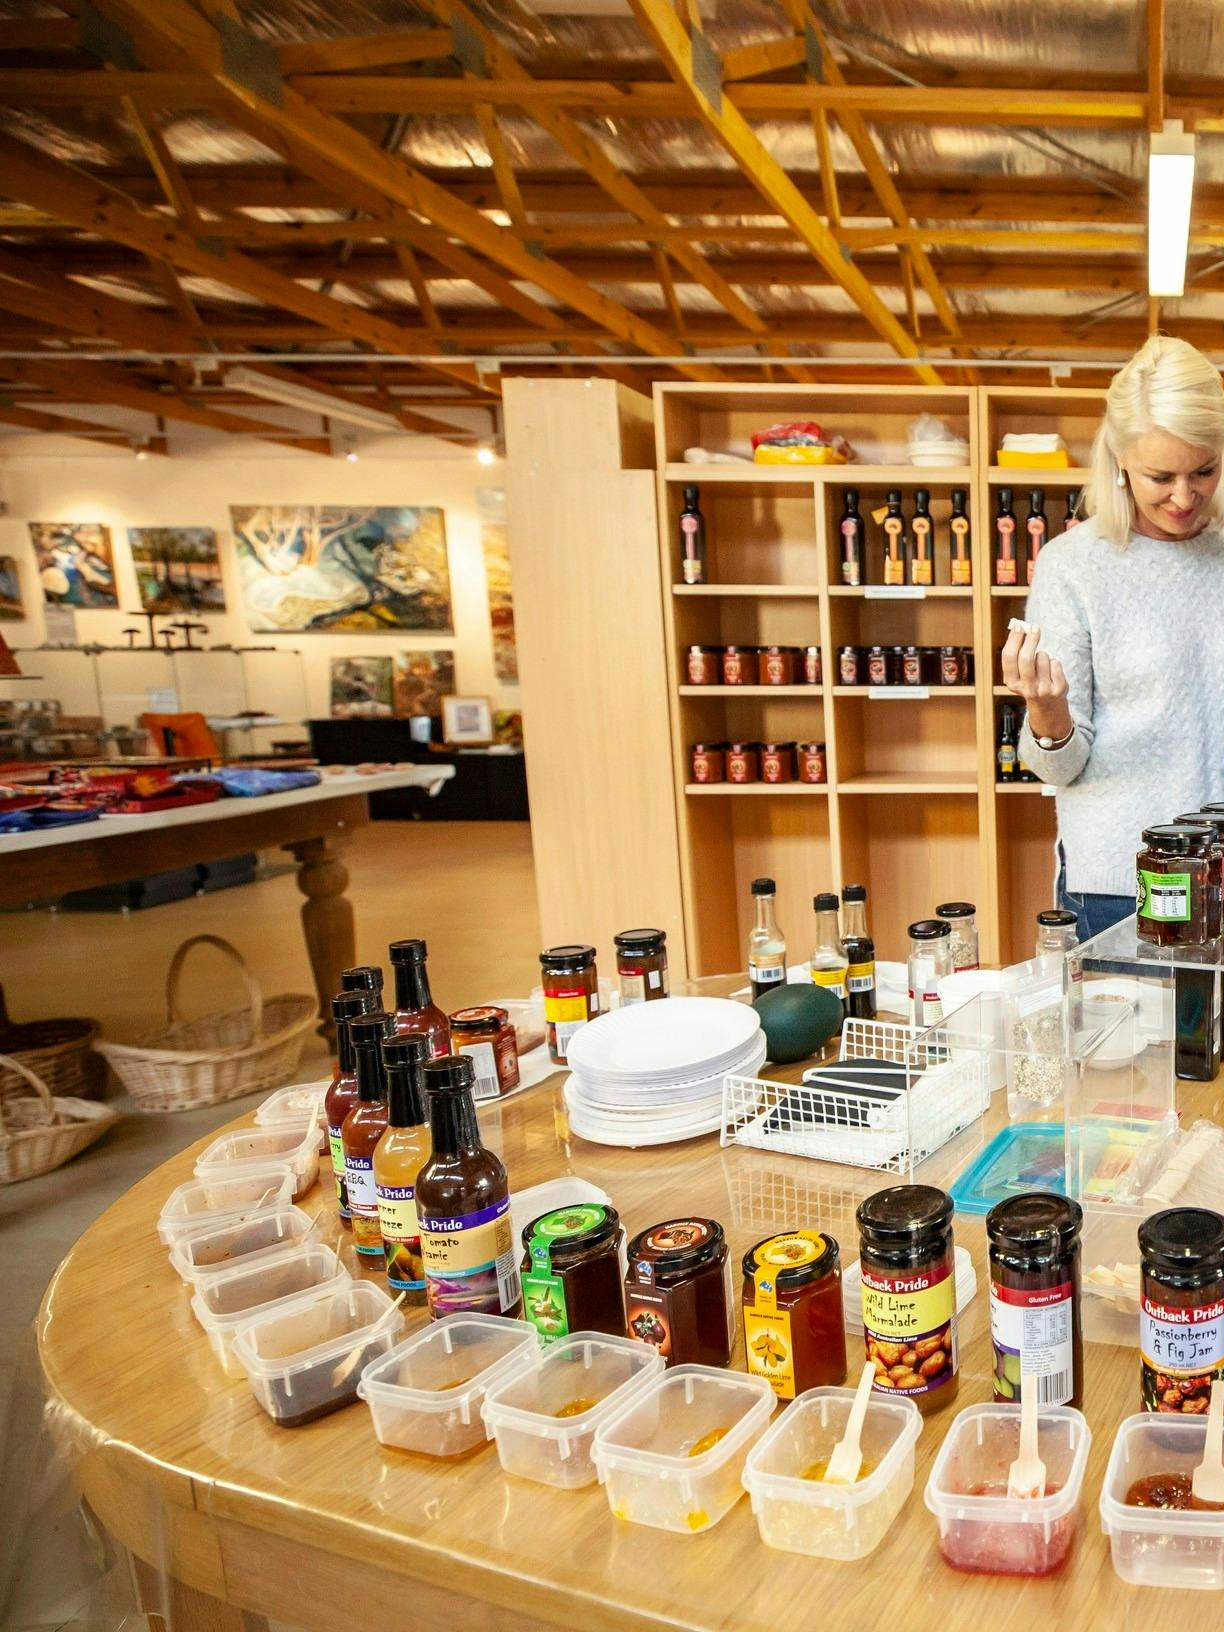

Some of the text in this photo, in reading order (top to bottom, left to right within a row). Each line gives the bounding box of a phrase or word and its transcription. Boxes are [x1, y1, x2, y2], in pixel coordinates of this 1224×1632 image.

[328, 1126, 341, 1137] Prid
[347, 1158, 370, 1169] Pride
[384, 1188, 413, 1199] Pride
[431, 1219, 463, 1231] Pride
[423, 1233, 460, 1247] Tomato
[895, 1277, 929, 1292] Pride
[866, 1293, 916, 1312] Wild Lime
[1028, 1293, 1062, 1304] Gluten Free
[866, 1306, 918, 1327] Marmalade
[1145, 1299, 1224, 1323] Outback Pride
[1149, 1319, 1218, 1341] Passionberry
[1154, 1338, 1213, 1362] & Fig Jam
[909, 1385, 929, 1394] FOODS
